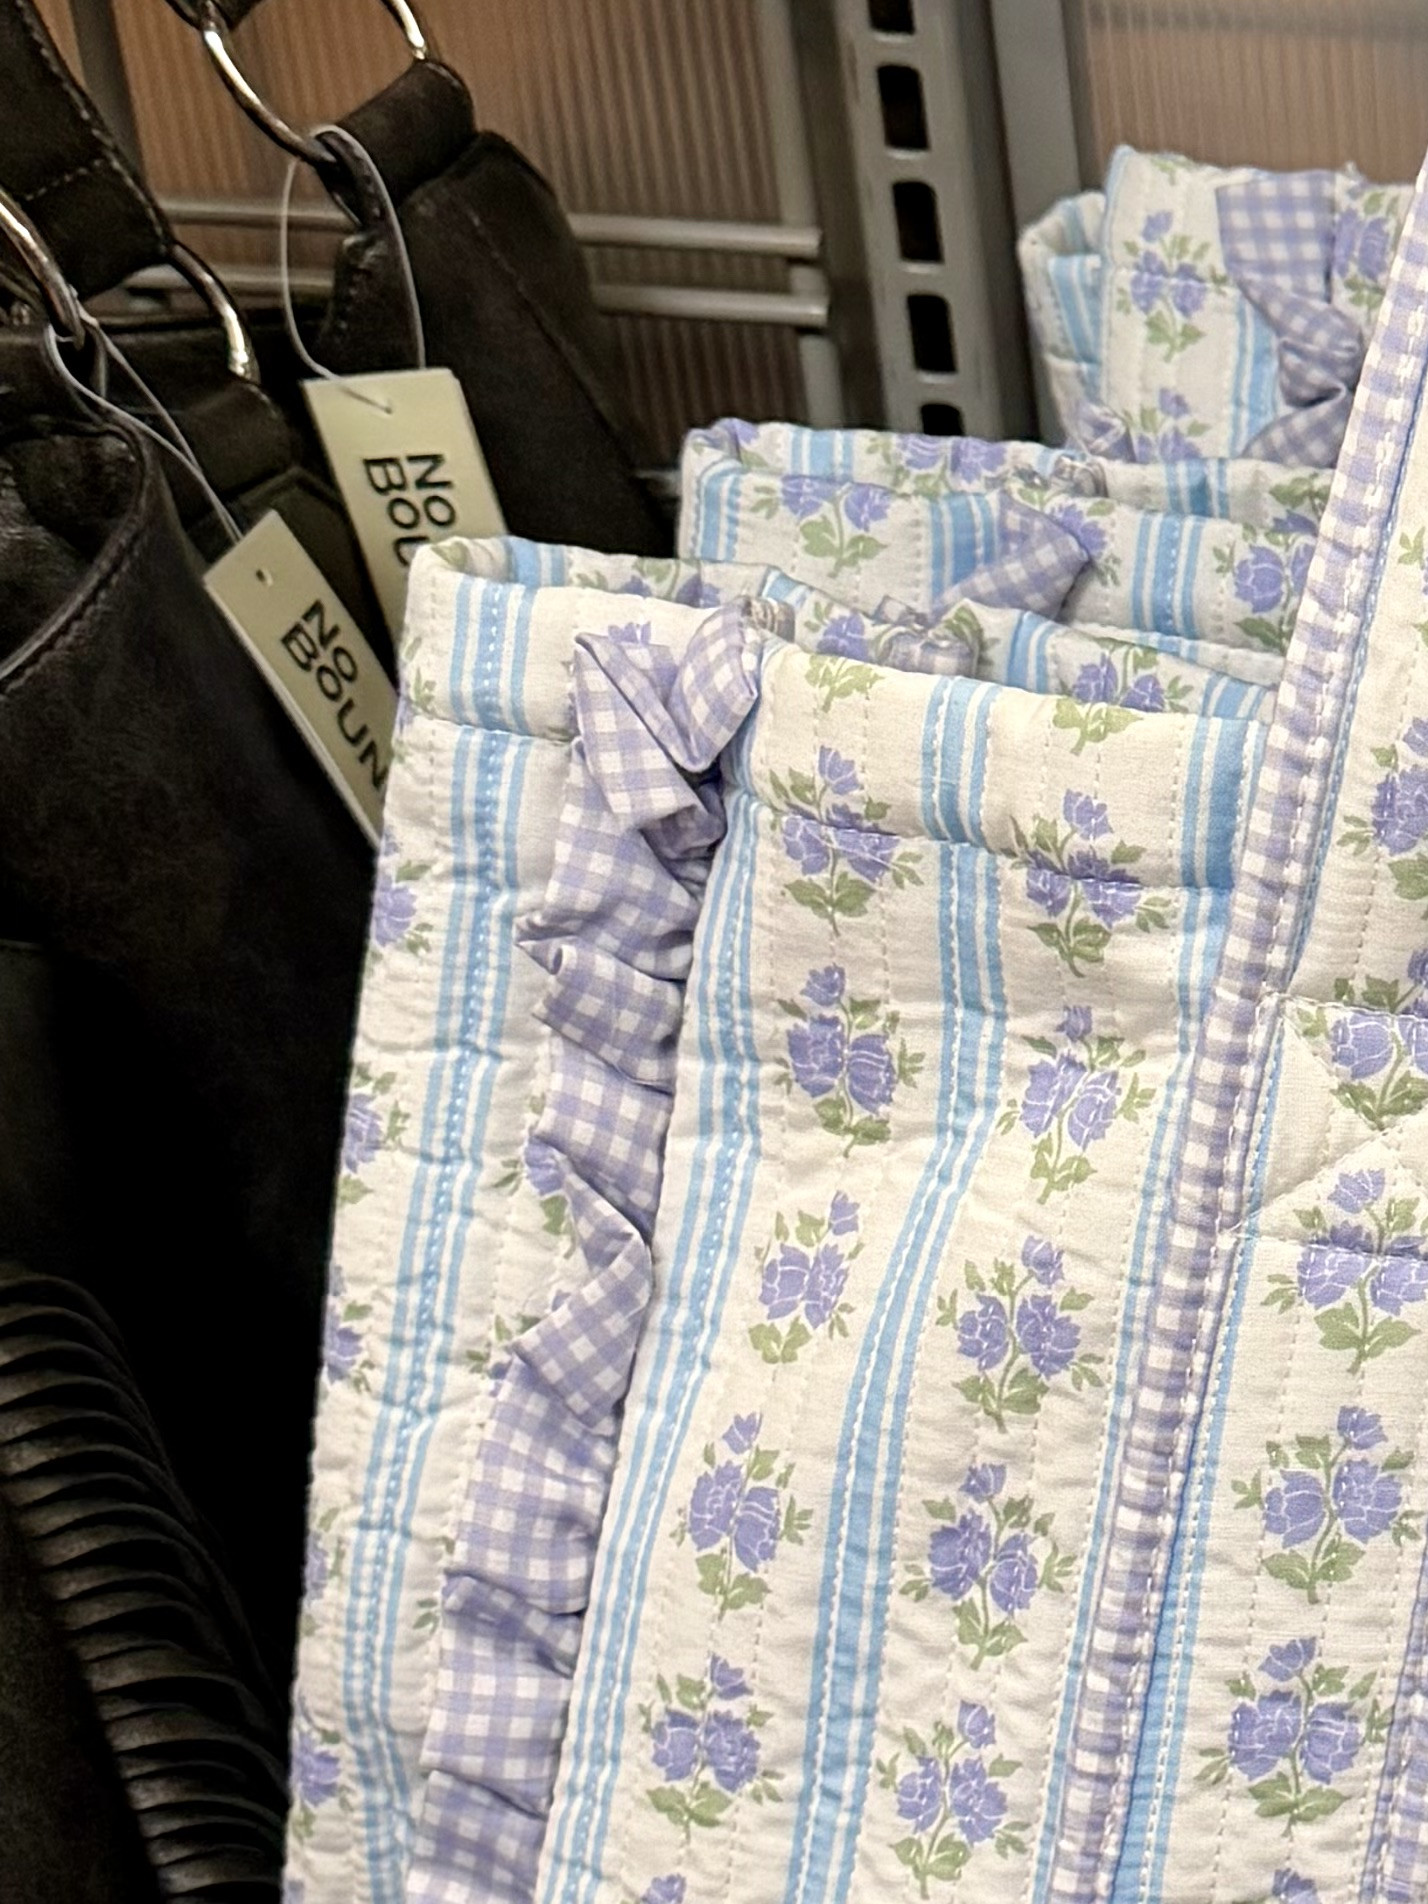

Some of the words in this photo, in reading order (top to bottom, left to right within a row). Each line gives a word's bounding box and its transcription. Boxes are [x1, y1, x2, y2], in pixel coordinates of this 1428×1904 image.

[362, 457, 430, 567] BOU
[405, 453, 456, 528] NO
[302, 598, 359, 683] NO
[281, 621, 389, 791] BOUN
